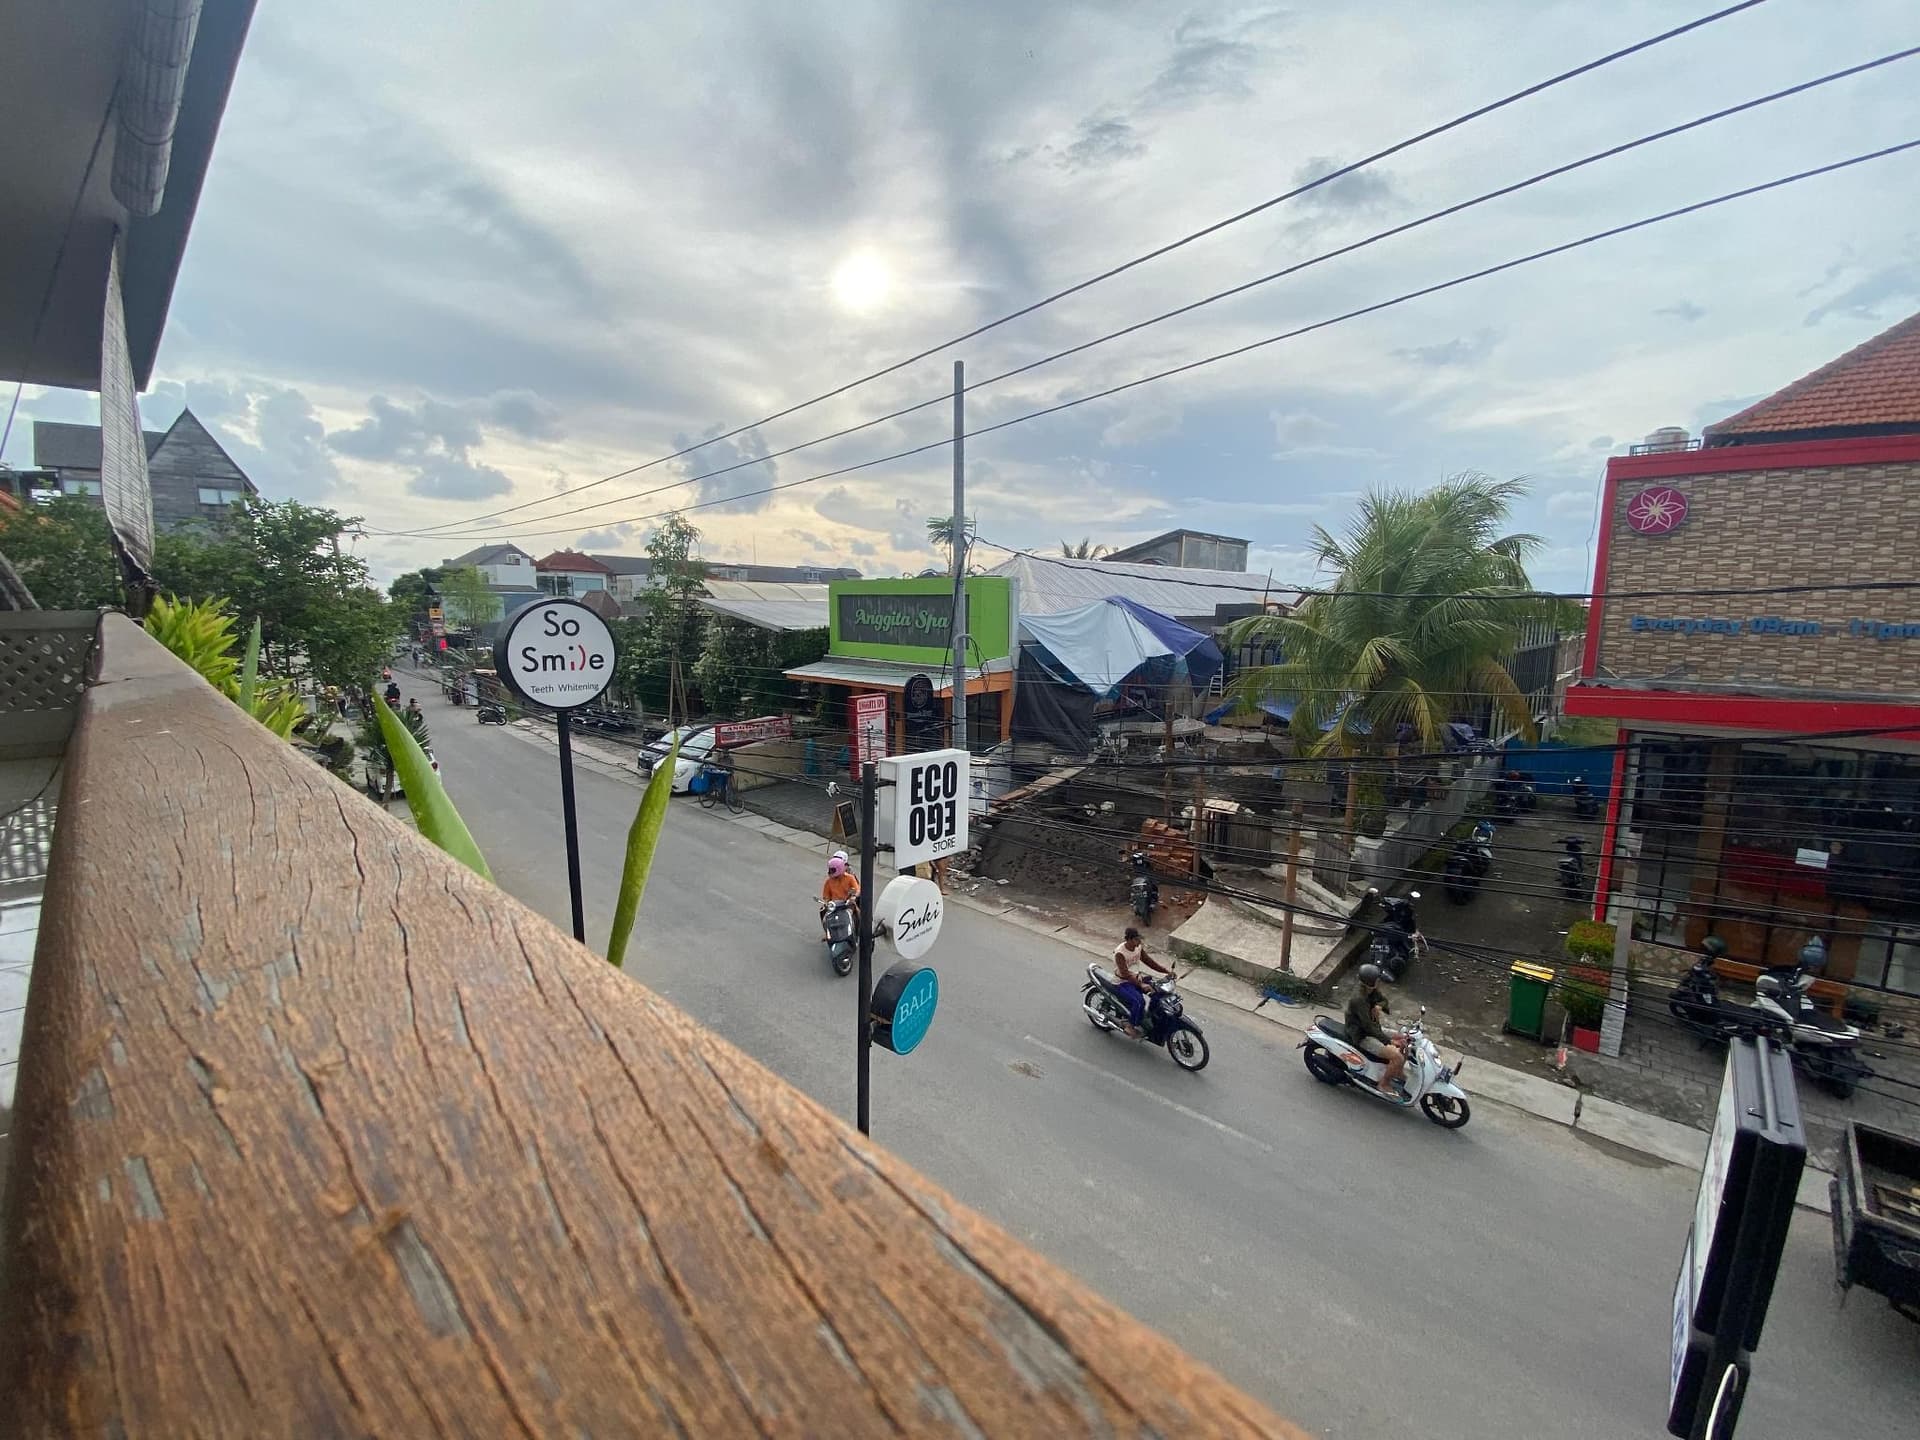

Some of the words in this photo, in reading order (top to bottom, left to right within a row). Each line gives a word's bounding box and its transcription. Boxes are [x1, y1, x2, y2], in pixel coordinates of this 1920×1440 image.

[544, 610, 580, 637] So
[915, 610, 950, 633] Spa
[1631, 614, 1743, 636] Everyday
[1750, 615, 1821, 635] 09am
[531, 685, 554, 694] Teeth
[558, 682, 599, 692] Whitening
[911, 761, 957, 806] ECO
[932, 837, 956, 852] STORE
[898, 901, 940, 940] Suki
[899, 981, 934, 1024] BALI
